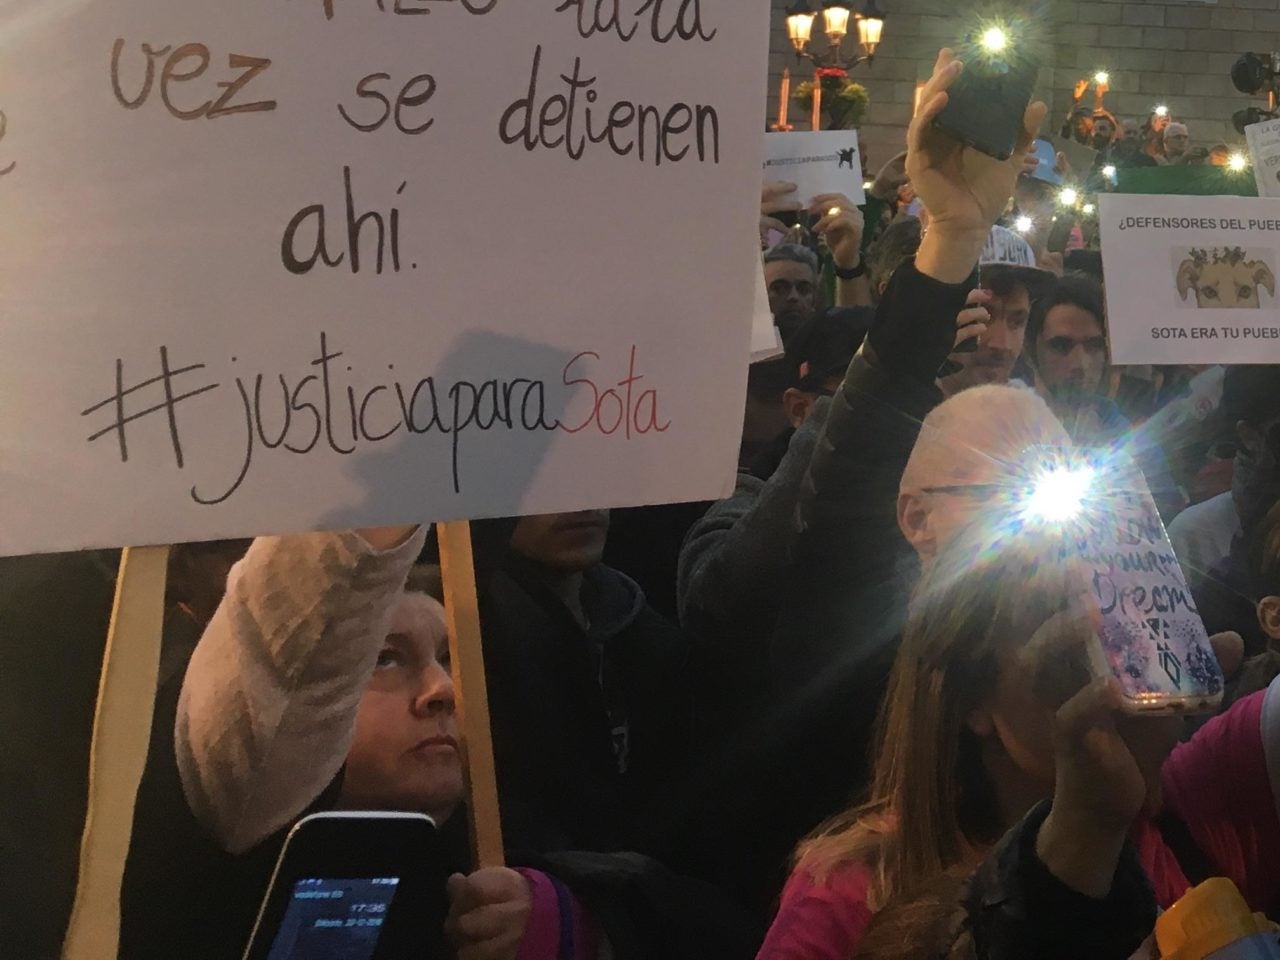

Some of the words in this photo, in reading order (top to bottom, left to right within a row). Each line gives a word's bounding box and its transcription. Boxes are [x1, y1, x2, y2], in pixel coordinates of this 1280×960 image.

[110, 38, 277, 120] vez
[337, 72, 436, 135] se
[499, 45, 719, 164] detienen
[1261, 126, 1270, 134] LA
[281, 166, 418, 275] ahí.
[1118, 216, 1217, 231] ¿DEFENSORES
[1220, 218, 1246, 230] DEL
[1151, 327, 1188, 339] SOTA
[1191, 327, 1218, 339] ERA
[1221, 327, 1239, 339] TU
[81, 332, 673, 504] #justiciaparaSota
